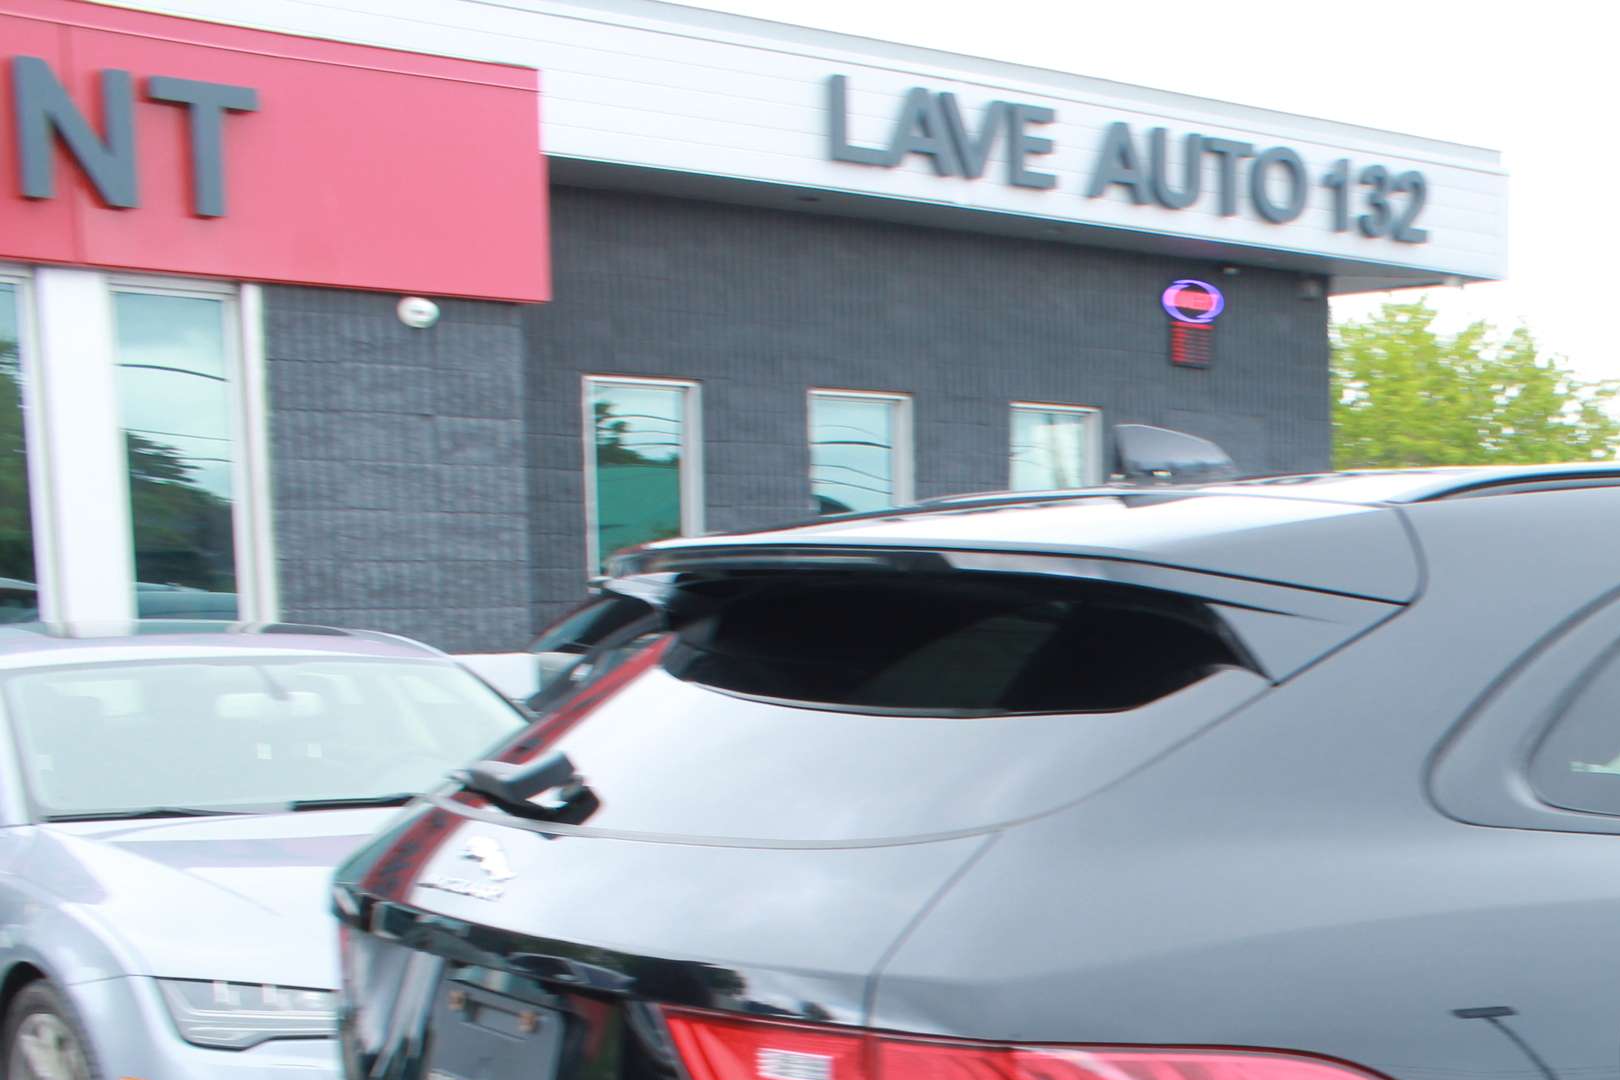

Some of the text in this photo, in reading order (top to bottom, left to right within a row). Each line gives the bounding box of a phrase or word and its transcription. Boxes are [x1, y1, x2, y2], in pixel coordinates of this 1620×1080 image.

[12, 55, 260, 218] NT
[826, 74, 1430, 244] LAVE AUTO 132
